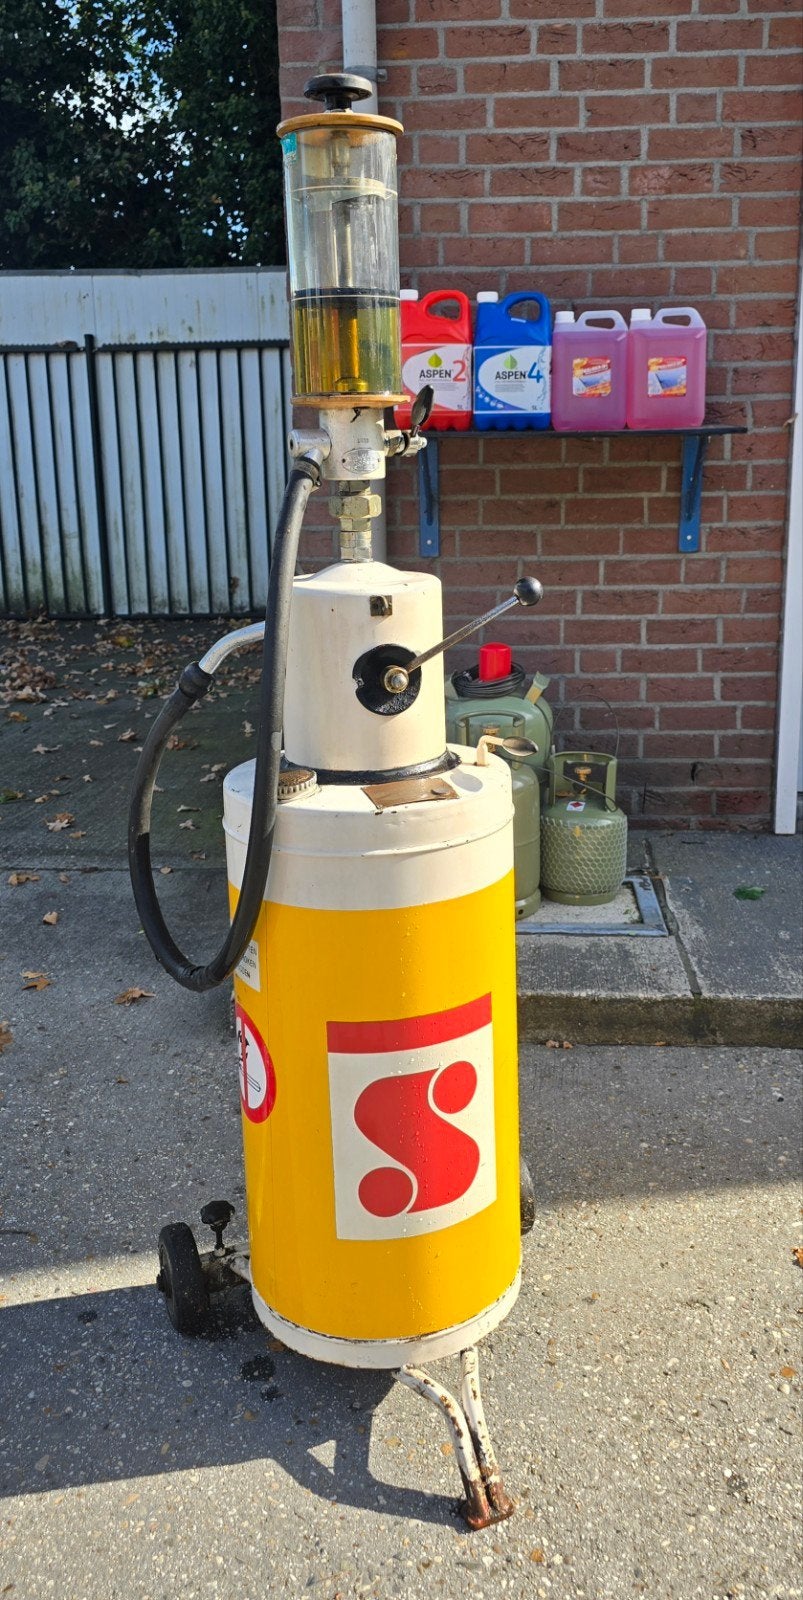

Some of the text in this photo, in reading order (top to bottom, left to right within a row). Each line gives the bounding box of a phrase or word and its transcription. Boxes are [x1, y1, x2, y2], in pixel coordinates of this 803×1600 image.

[419, 360, 466, 382] ASPEN 2
[495, 362, 543, 384] ASPEN 4
